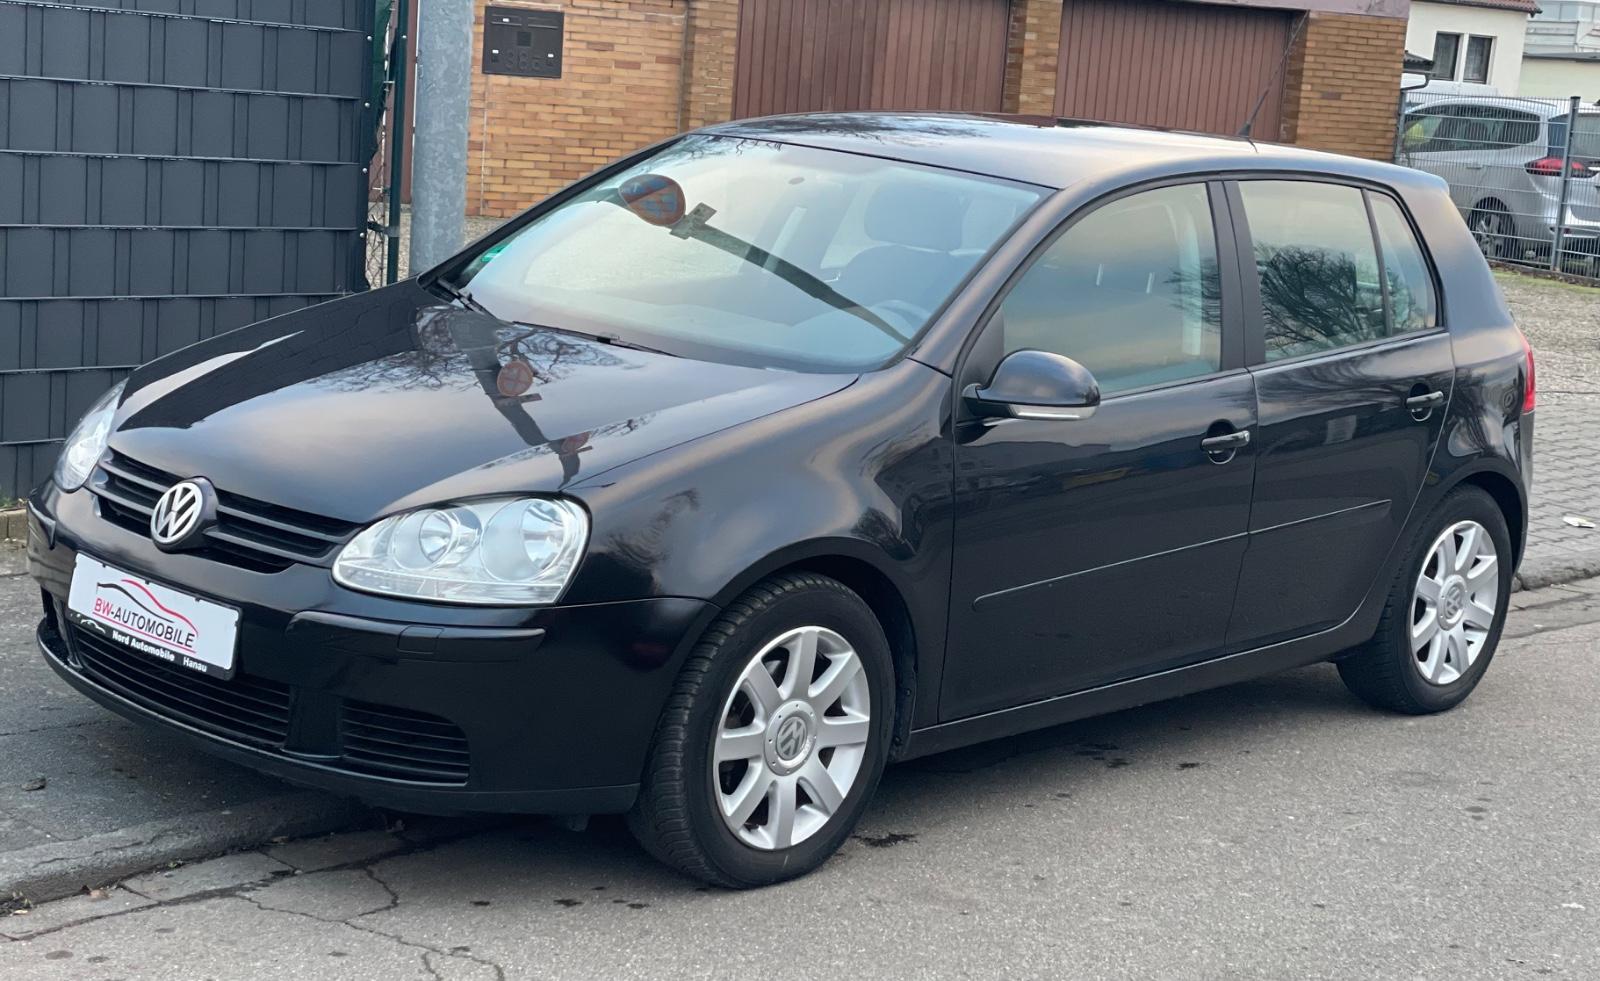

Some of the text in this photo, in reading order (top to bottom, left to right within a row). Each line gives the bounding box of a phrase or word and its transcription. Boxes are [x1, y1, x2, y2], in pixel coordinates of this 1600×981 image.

[151, 482, 203, 543] VW
[94, 598, 195, 648] BW-AUTOMOBILE
[112, 630, 208, 673] Nord Automobile Hanau
